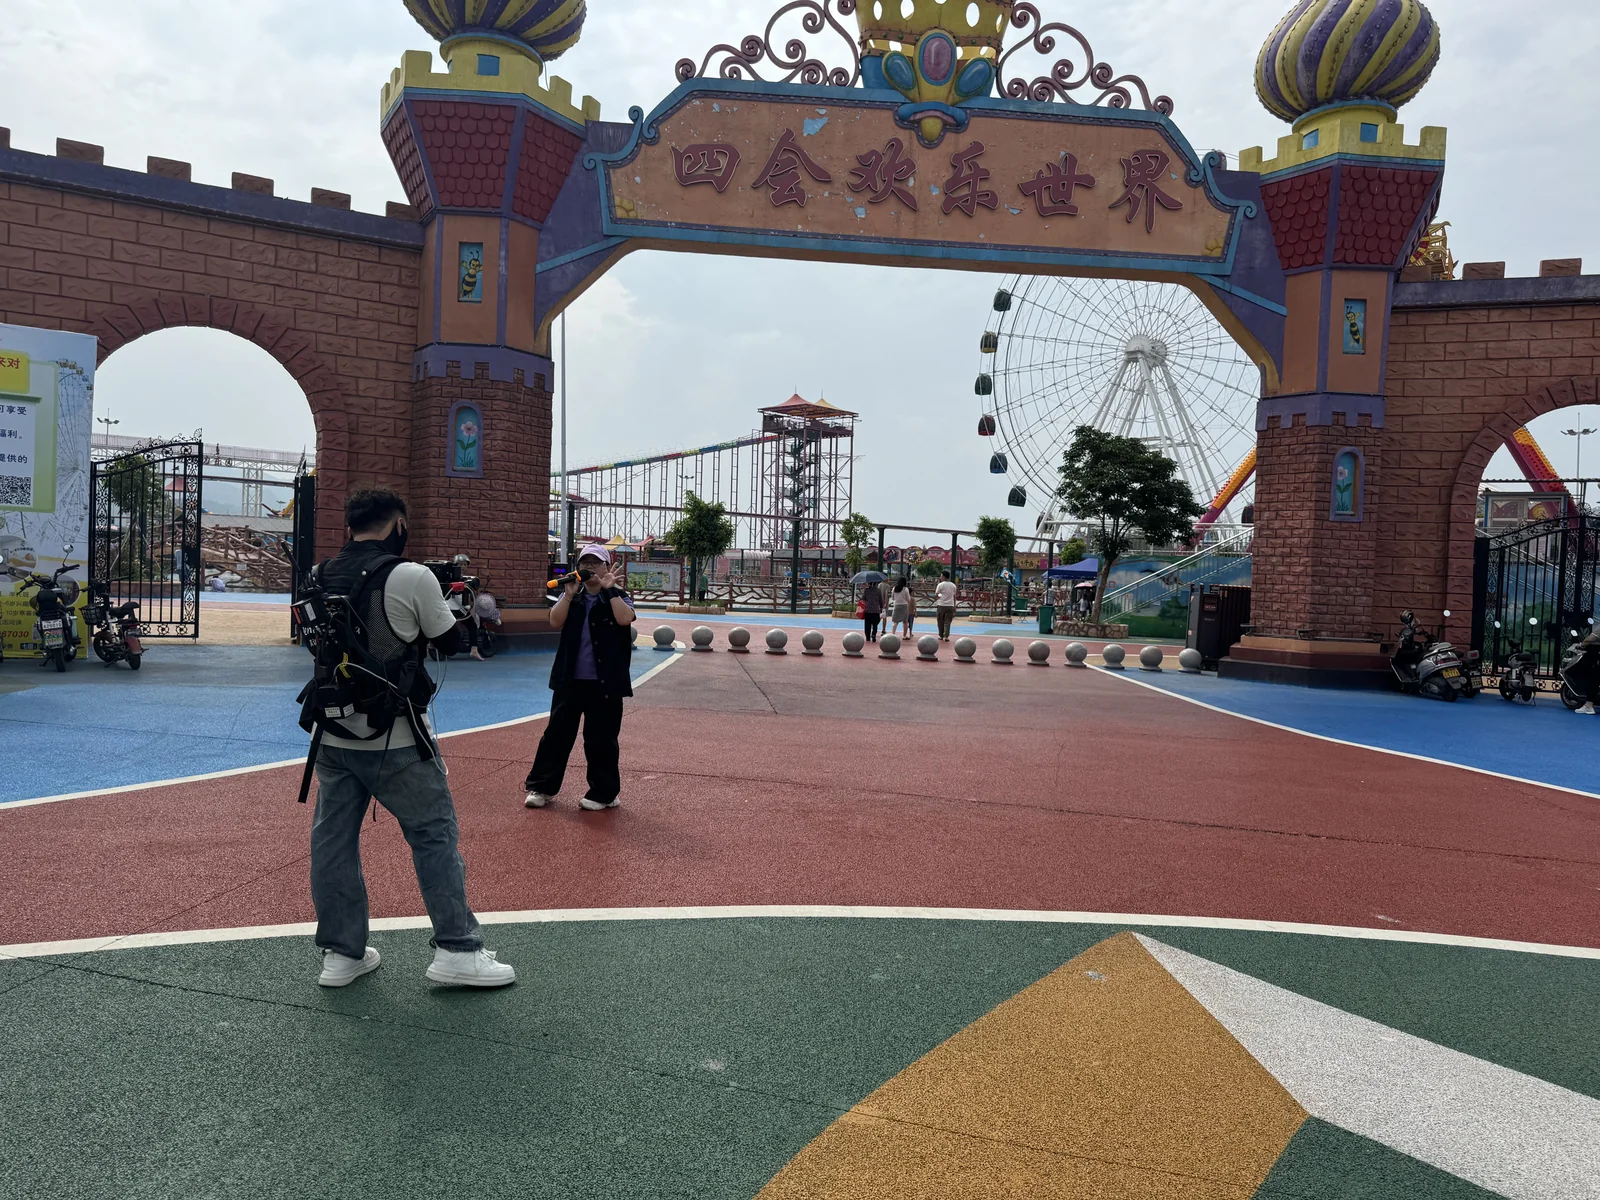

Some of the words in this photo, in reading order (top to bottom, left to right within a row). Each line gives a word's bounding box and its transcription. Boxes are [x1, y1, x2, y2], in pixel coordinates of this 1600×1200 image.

[670, 128, 1184, 233] 四会欢乐世界
